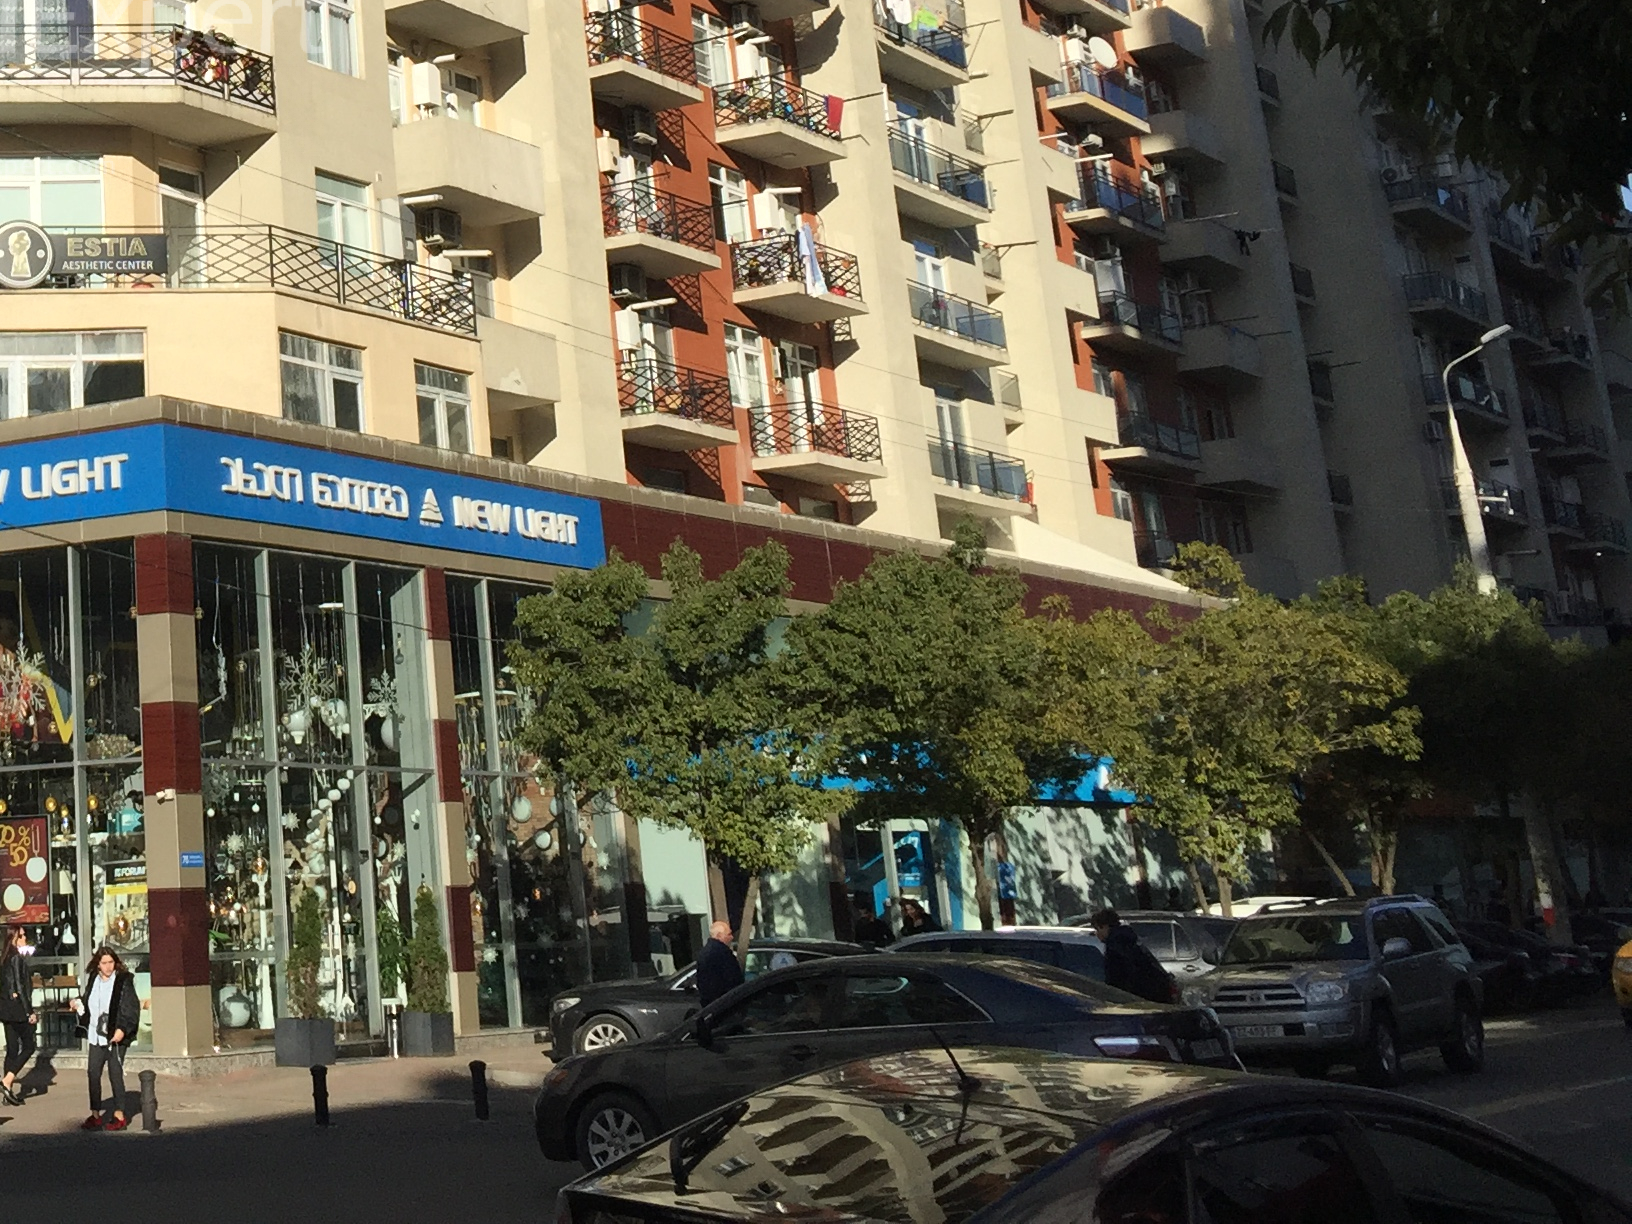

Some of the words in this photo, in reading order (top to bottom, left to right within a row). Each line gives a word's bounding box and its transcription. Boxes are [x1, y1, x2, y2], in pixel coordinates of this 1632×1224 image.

[67, 237, 148, 257] ESTIA
[62, 261, 114, 270] AESTHETIC
[116, 261, 154, 270] CENTER
[21, 453, 129, 500] LIGHT
[453, 496, 511, 534] NEW
[516, 506, 579, 545] LIGHT
[9, 842, 29, 867] 50
